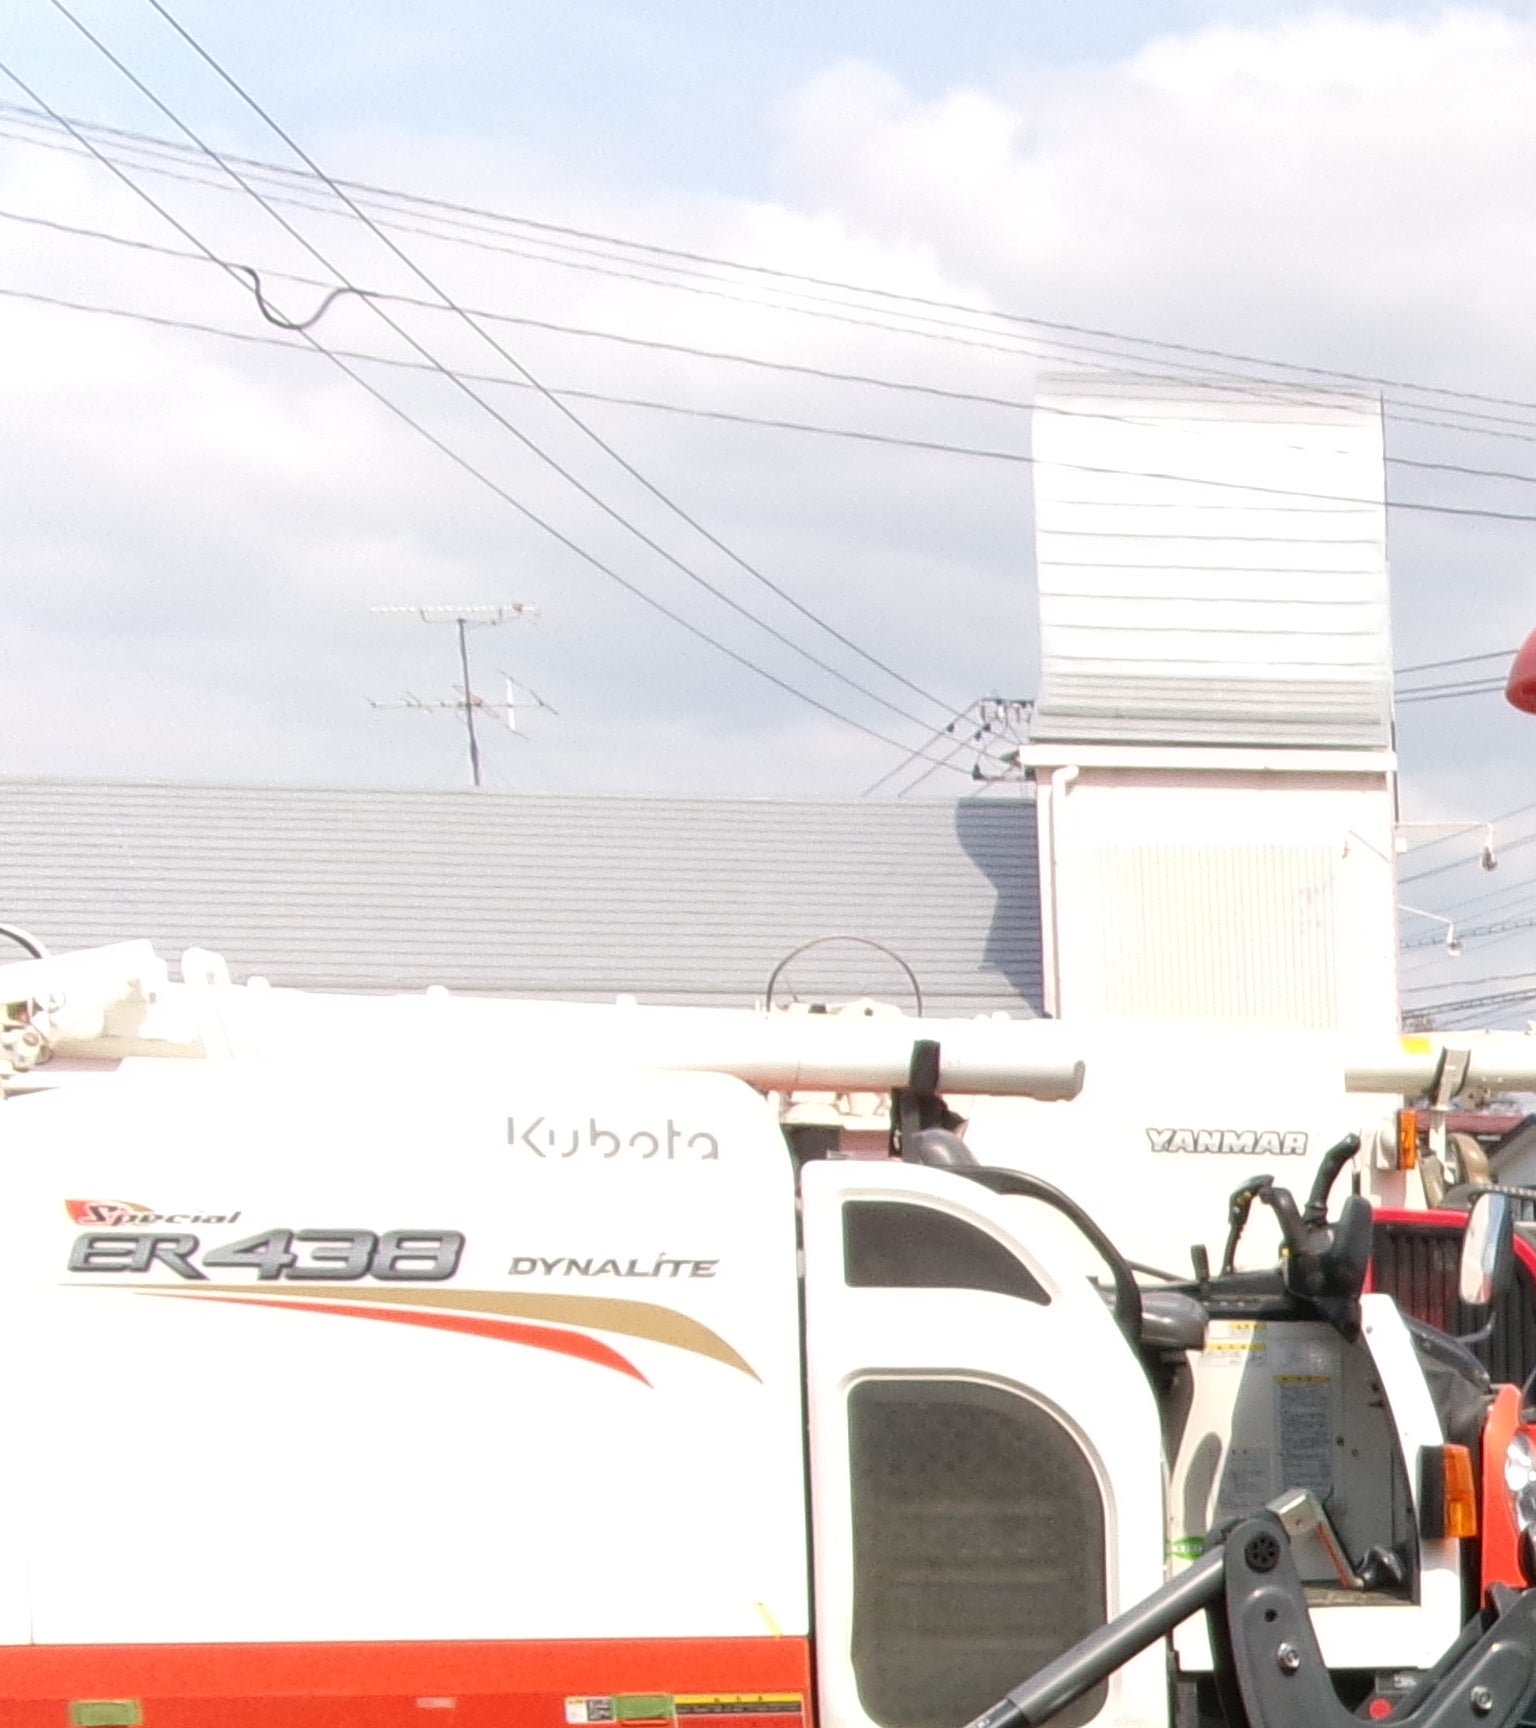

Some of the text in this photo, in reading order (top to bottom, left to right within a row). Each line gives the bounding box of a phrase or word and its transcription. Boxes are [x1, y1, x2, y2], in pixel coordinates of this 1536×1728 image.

[507, 1116, 719, 1160] Kubota
[1146, 1128, 1309, 1155] YANMAR
[83, 1205, 242, 1227] Special
[67, 1228, 467, 1281] ER438
[507, 1251, 720, 1278] DYNALITE
